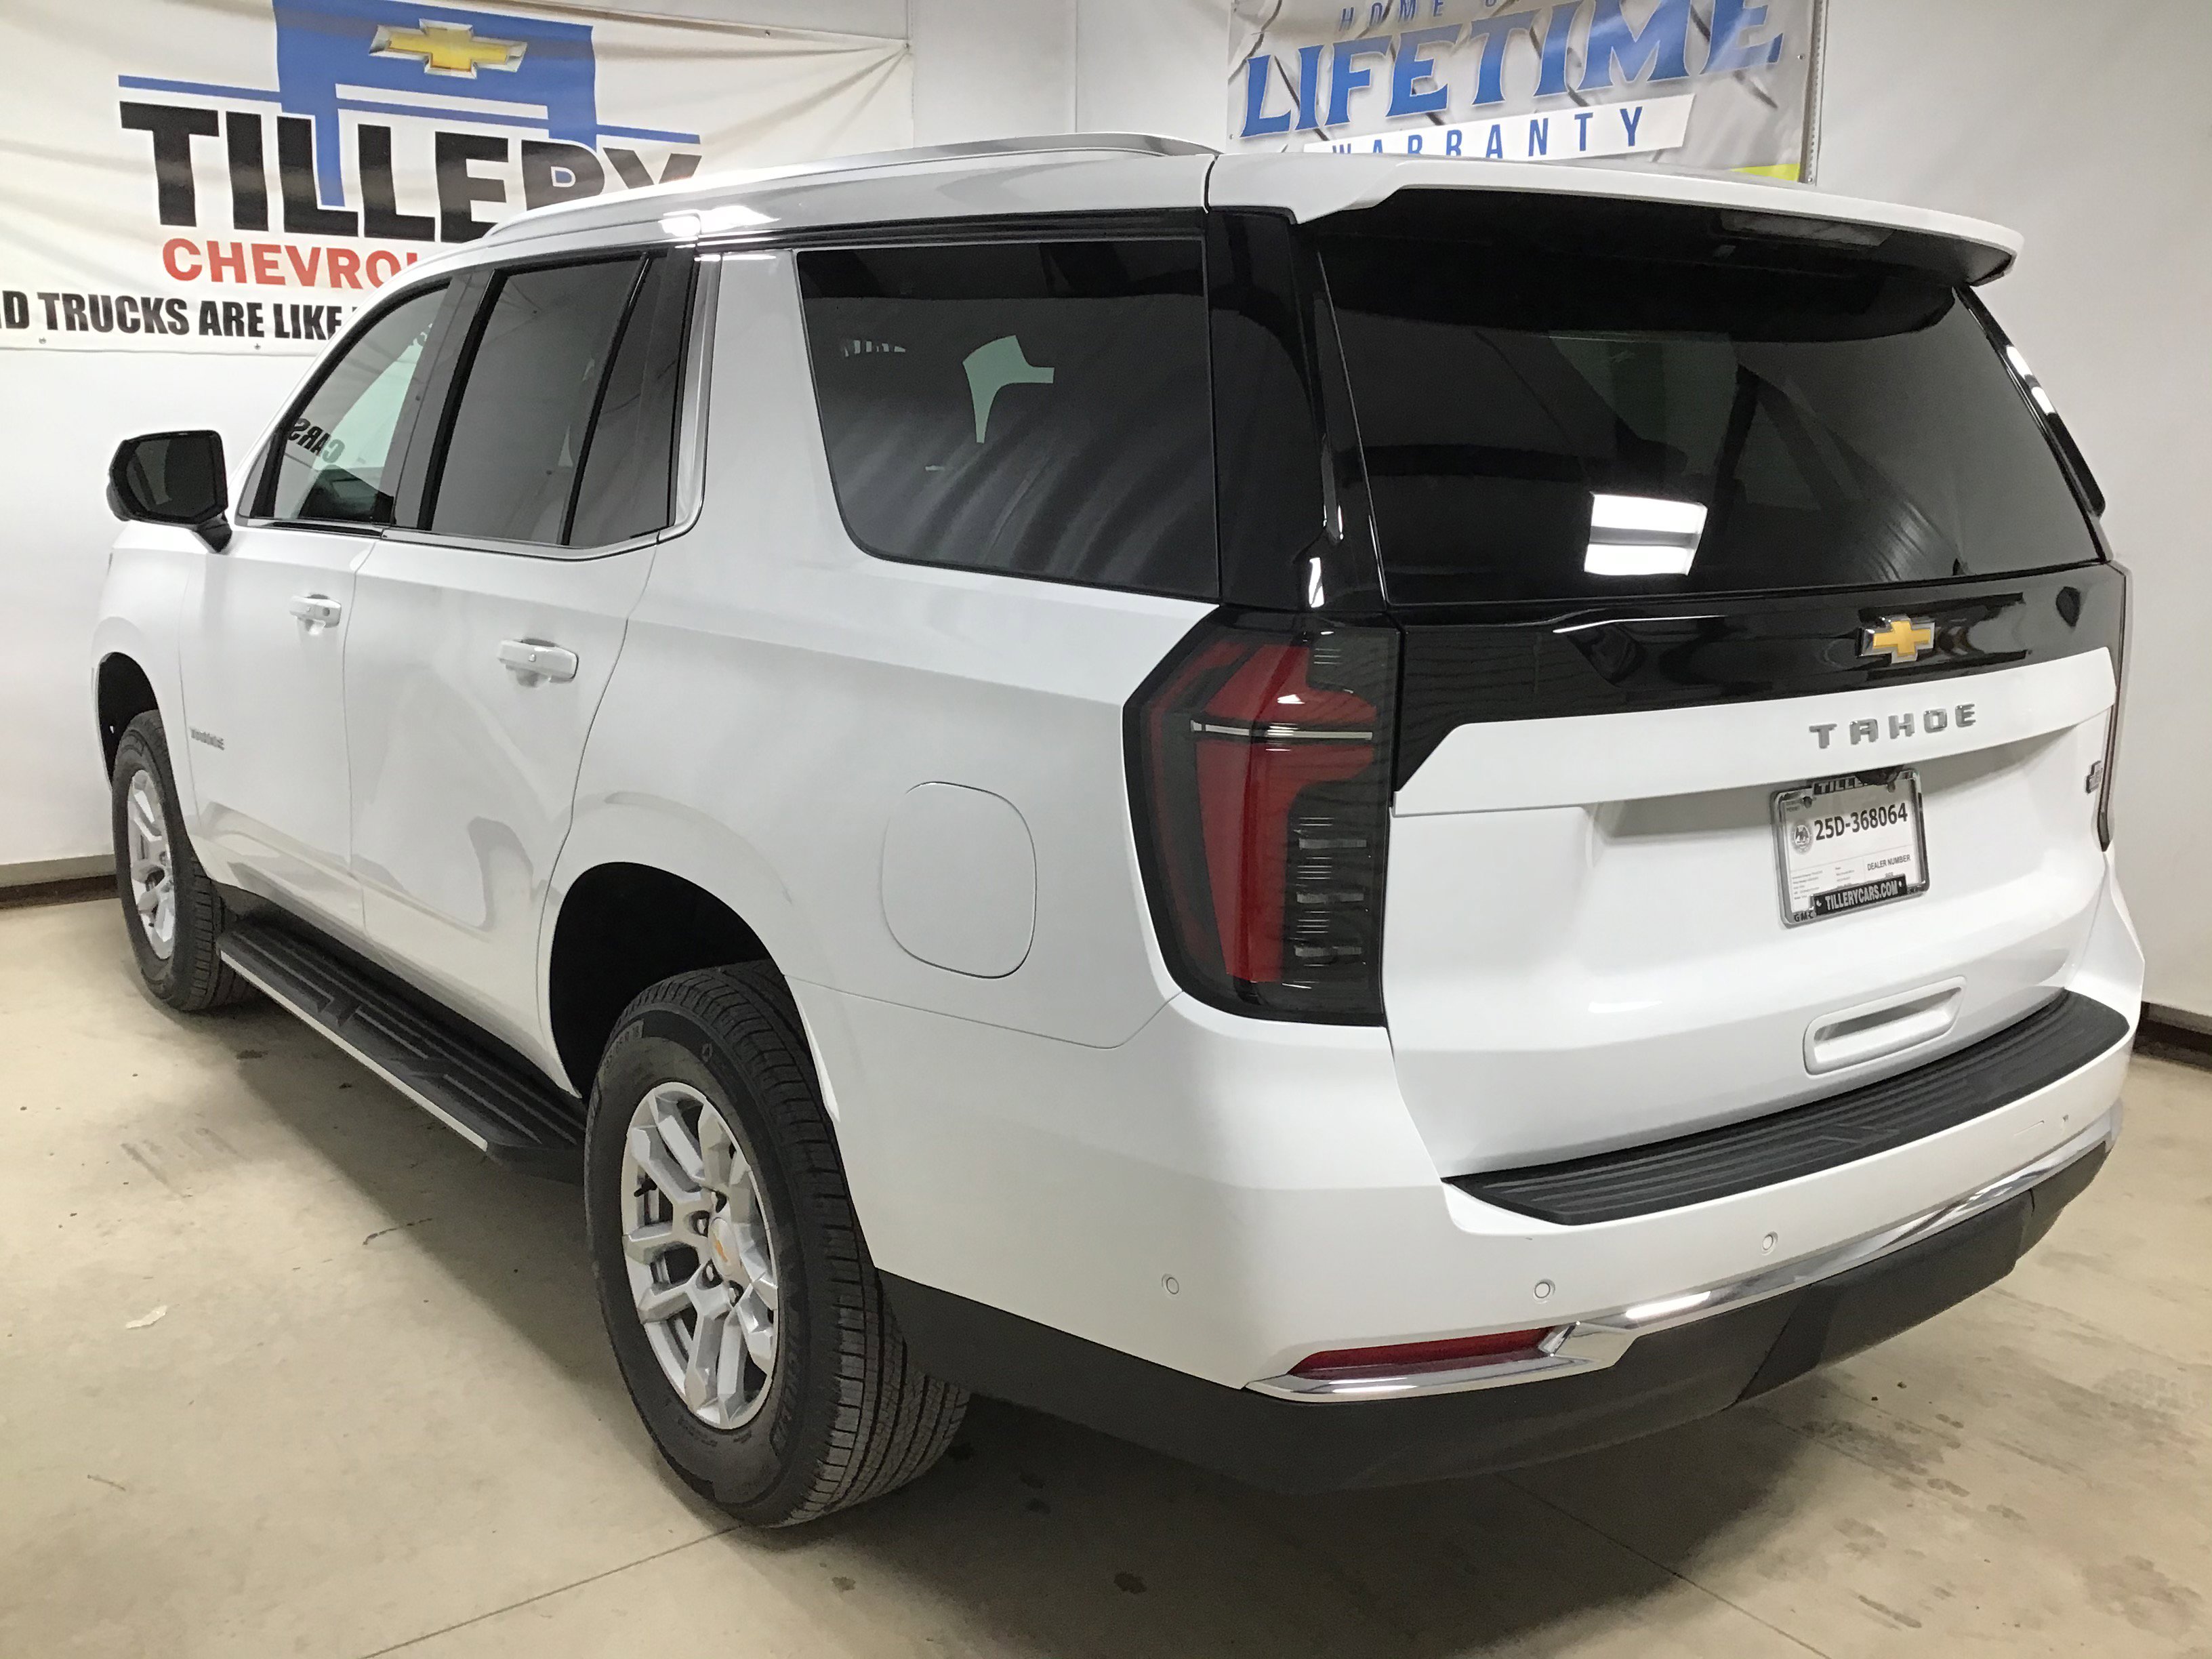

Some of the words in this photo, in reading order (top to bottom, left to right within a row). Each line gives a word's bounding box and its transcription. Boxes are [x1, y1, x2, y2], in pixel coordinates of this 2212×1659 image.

[1338, 0, 1445, 31] HOME
[1240, 0, 1784, 138] LIFETIME
[1332, 105, 1643, 159] RRANTY
[163, 238, 417, 289] CHEVRO
[37, 291, 190, 335] TRUCKS
[199, 300, 265, 337] ARE
[272, 303, 343, 340] LIKE
[1809, 703, 1977, 749] TAHOE
[1814, 802, 1908, 840] 25D-368064
[1867, 859, 1887, 871] DEALER
[1887, 854, 1911, 865] NUMBER
[1825, 880, 1898, 911] TILLERYCARS.COM
